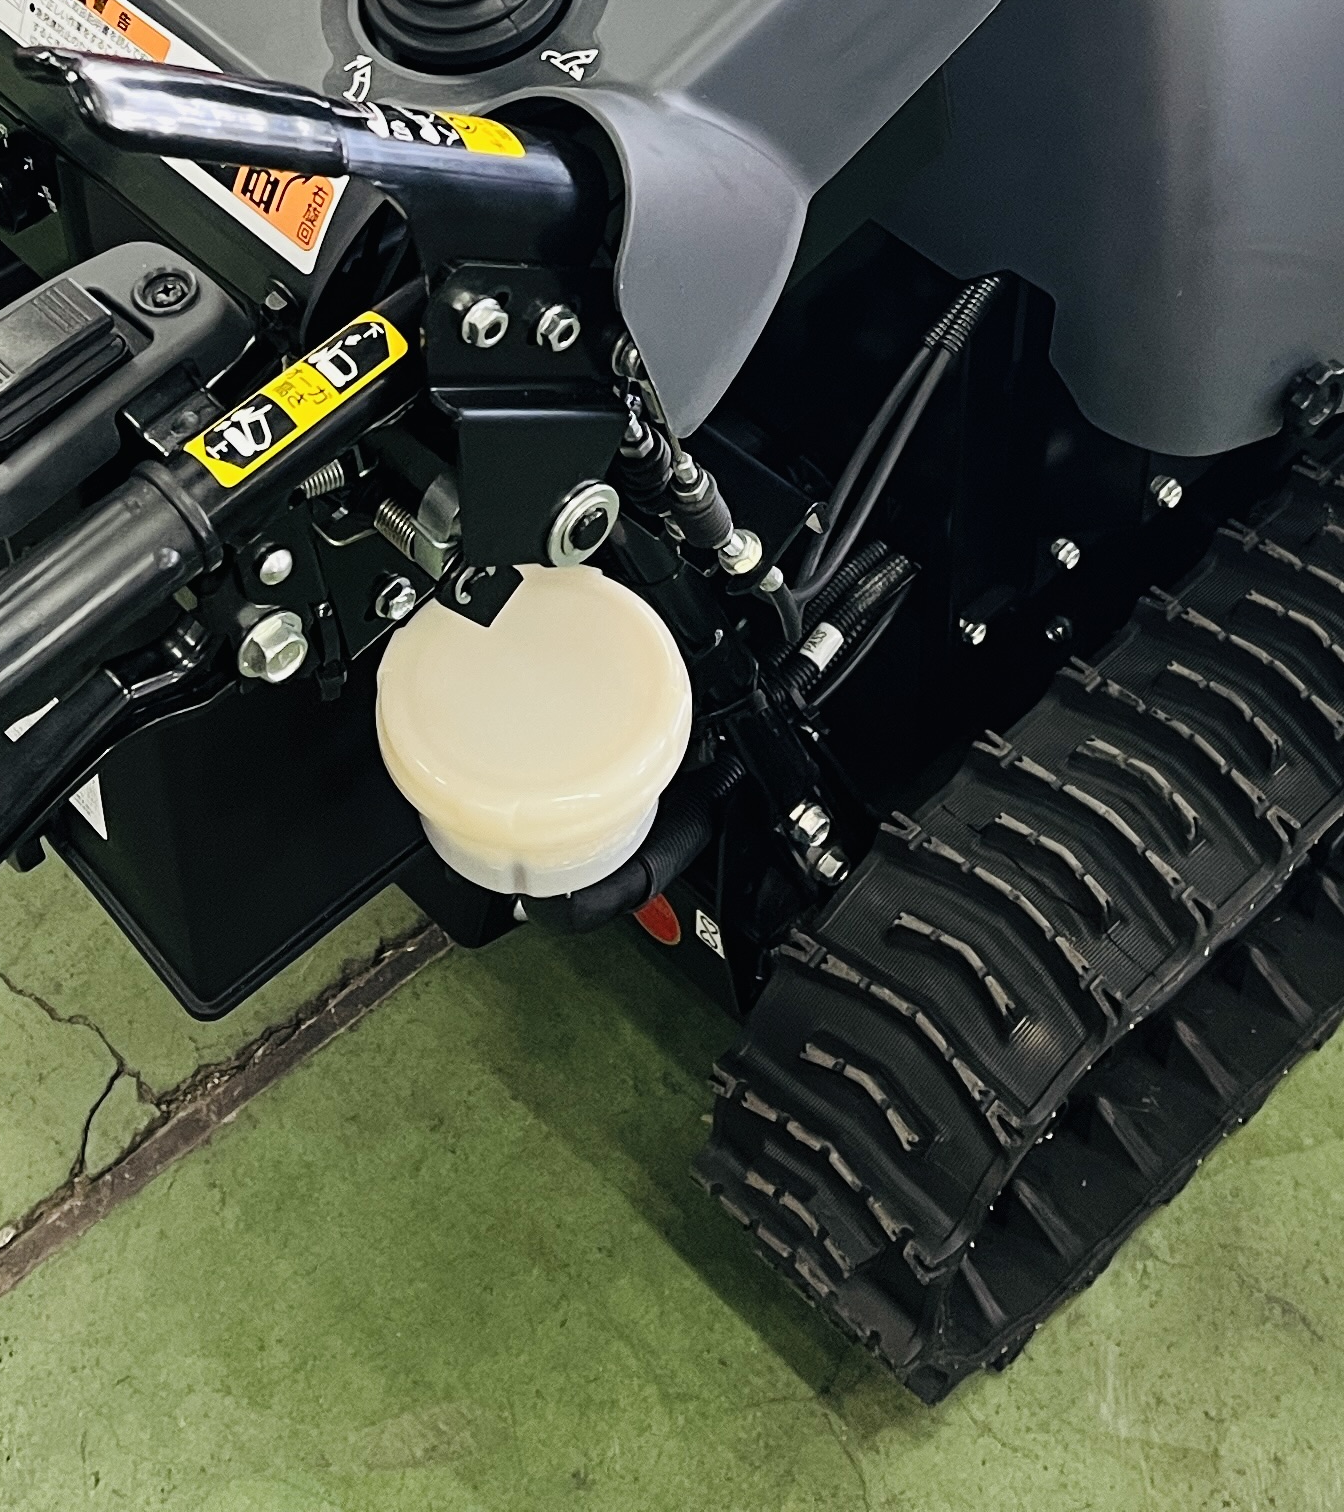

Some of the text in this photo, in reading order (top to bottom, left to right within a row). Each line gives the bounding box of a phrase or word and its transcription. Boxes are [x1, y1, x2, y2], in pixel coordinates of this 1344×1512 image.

[296, 184, 330, 246] 右旋回
[286, 367, 333, 406] オーガ
[802, 629, 828, 654] PASS
